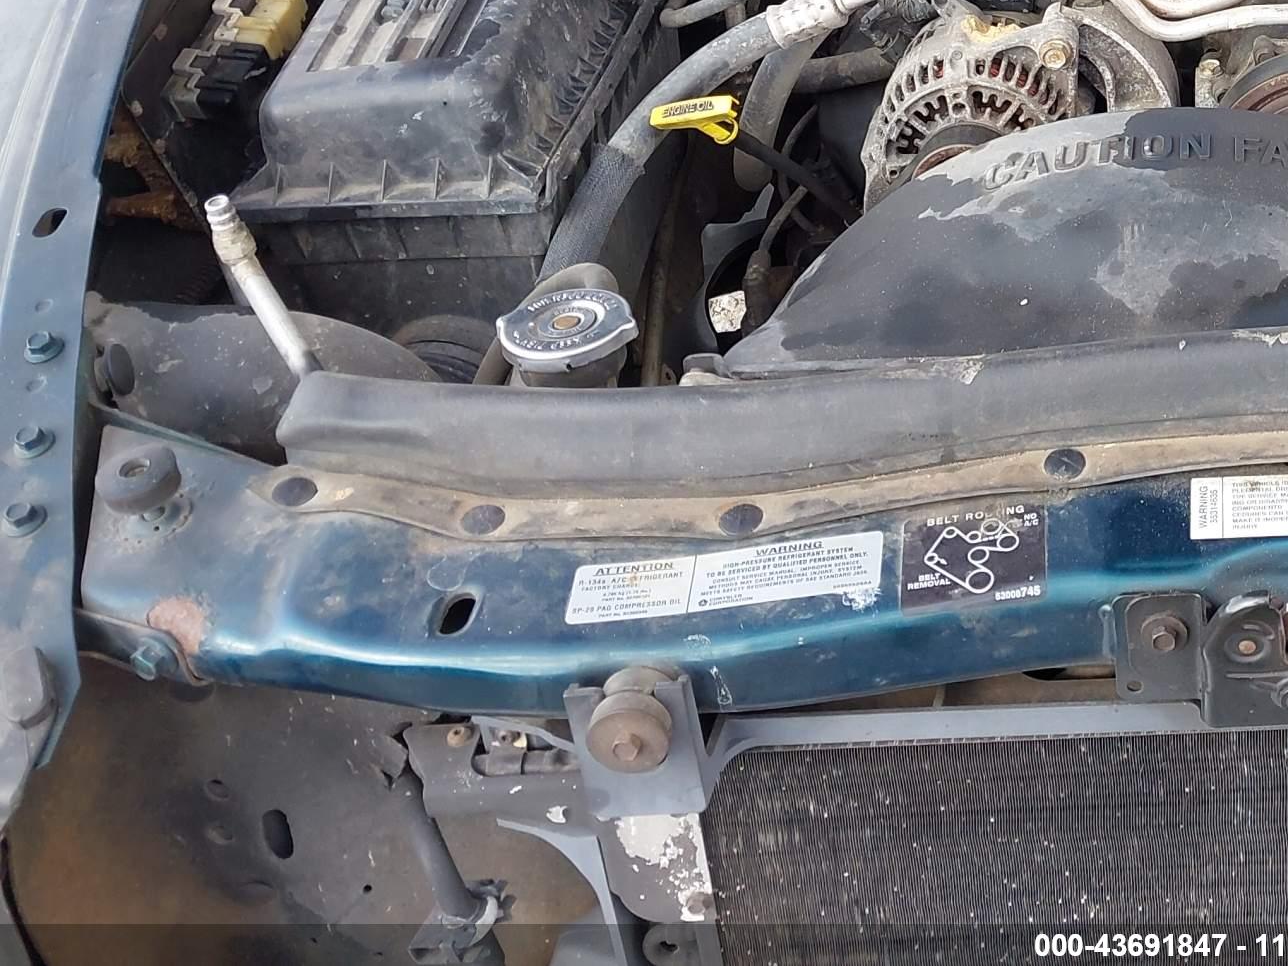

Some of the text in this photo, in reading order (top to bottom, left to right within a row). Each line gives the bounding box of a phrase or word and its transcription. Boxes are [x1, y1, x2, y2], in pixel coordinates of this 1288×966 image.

[662, 99, 715, 117] ENGINE OIL
[985, 133, 1211, 191] CAUTION
[1199, 485, 1208, 529] WARNING
[927, 505, 1025, 527] BELT ROING
[1024, 513, 1037, 521] NO
[1024, 519, 1039, 527] A/C
[755, 541, 823, 555] WARNING
[778, 551, 824, 561] REFRIGERANT
[595, 562, 673, 575] ATTENTION
[728, 566, 760, 574] SERVICED
[773, 561, 807, 569] QUALIFIED
[809, 556, 846, 564] PERSONNEL
[918, 572, 941, 581] BELT
[907, 577, 951, 591] REMOVAL
[615, 600, 666, 609] COMPRESSOR
